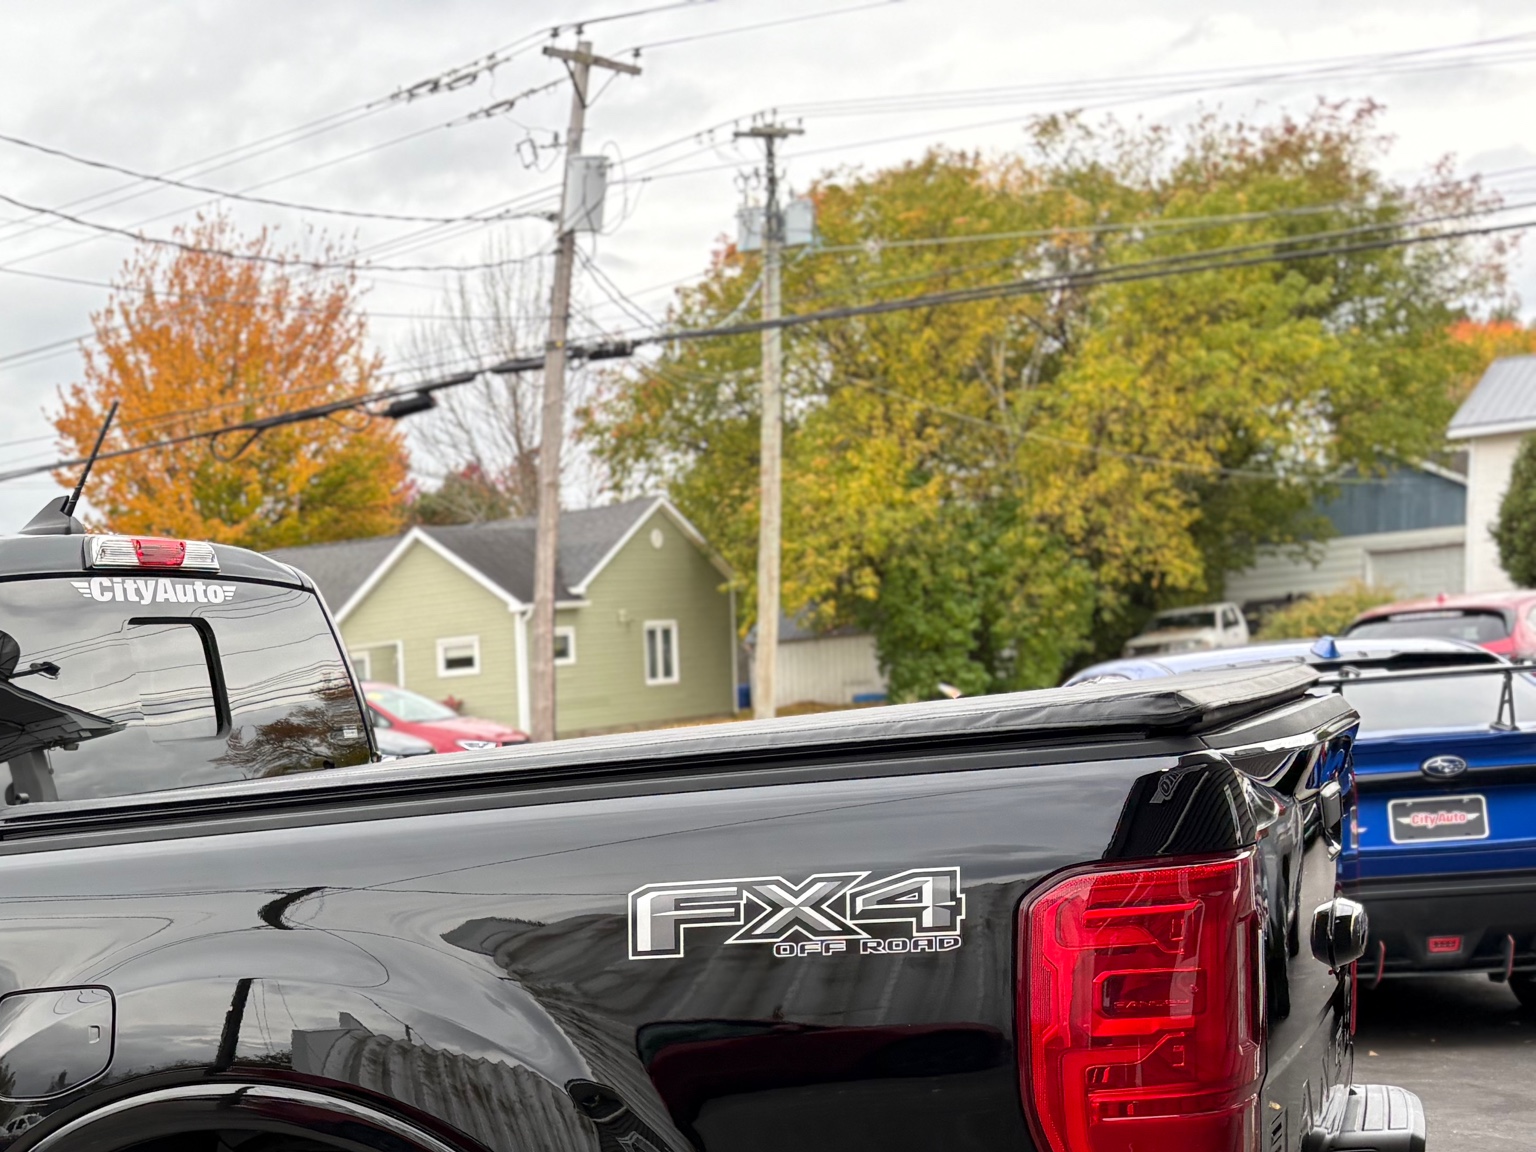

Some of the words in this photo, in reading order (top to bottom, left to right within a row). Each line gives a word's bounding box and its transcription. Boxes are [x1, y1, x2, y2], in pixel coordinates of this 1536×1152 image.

[90, 577, 225, 605] CityAuto
[628, 866, 965, 960] FX4
[773, 938, 847, 957] OFF
[859, 935, 962, 955] ROAD
